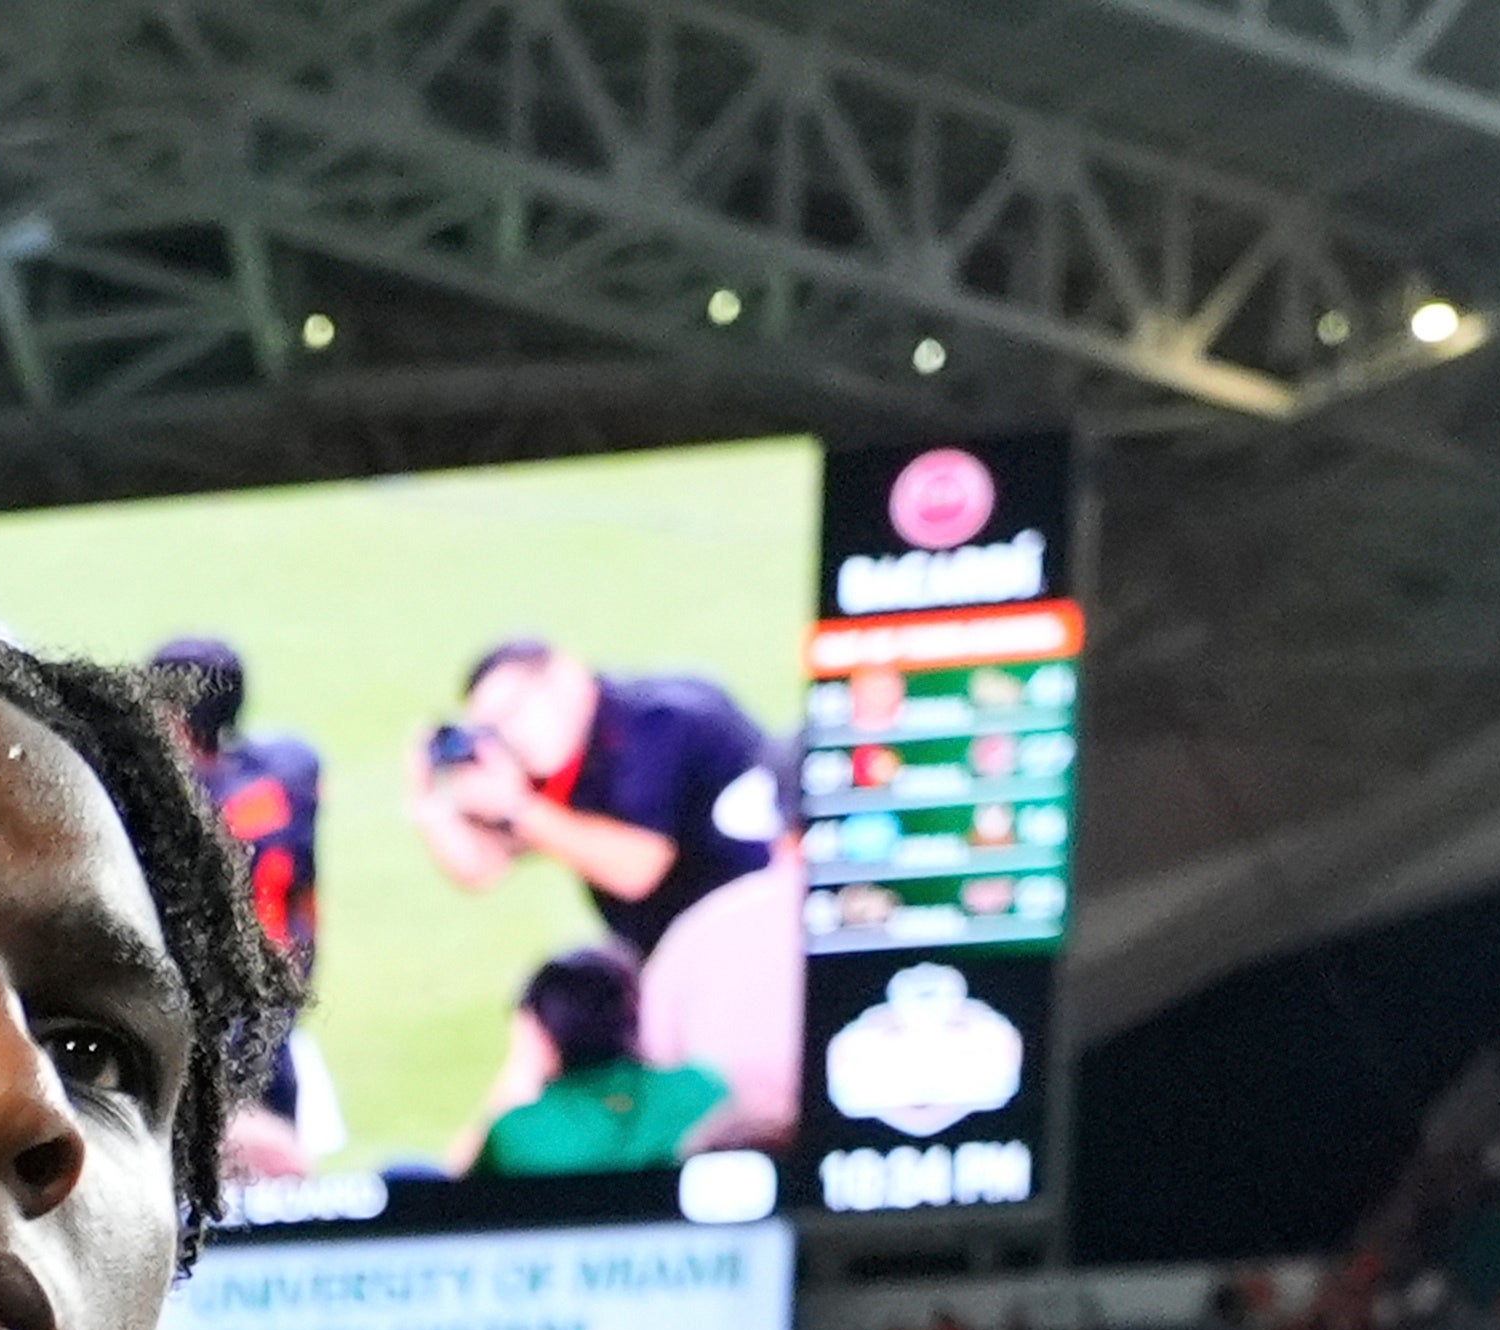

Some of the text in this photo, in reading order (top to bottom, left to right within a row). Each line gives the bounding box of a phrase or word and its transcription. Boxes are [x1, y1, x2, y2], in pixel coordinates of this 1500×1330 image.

[191, 1249, 744, 1312] UNIVERSITY OF MIAMI
